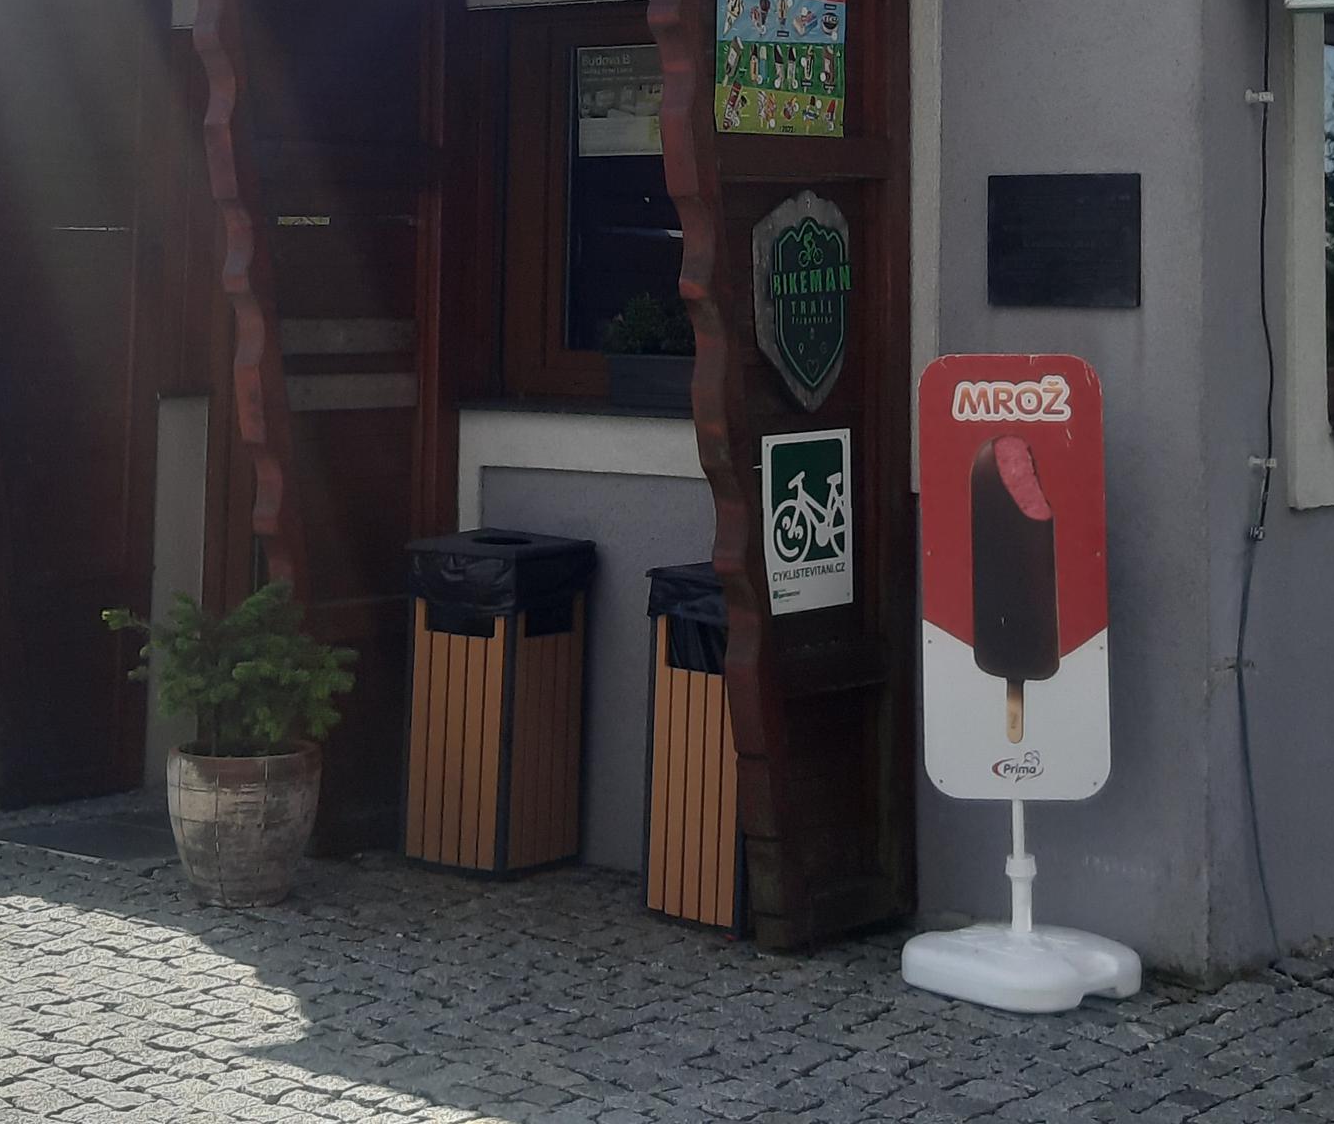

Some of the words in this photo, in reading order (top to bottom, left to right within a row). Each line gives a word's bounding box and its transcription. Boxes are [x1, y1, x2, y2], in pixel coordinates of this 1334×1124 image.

[773, 264, 851, 296] BIKEMAN
[791, 300, 832, 315] TRAIL
[956, 378, 1067, 416] MROŽ
[772, 562, 846, 582] CYKLISTEVITANI.CZ
[1003, 763, 1037, 775] Prima
